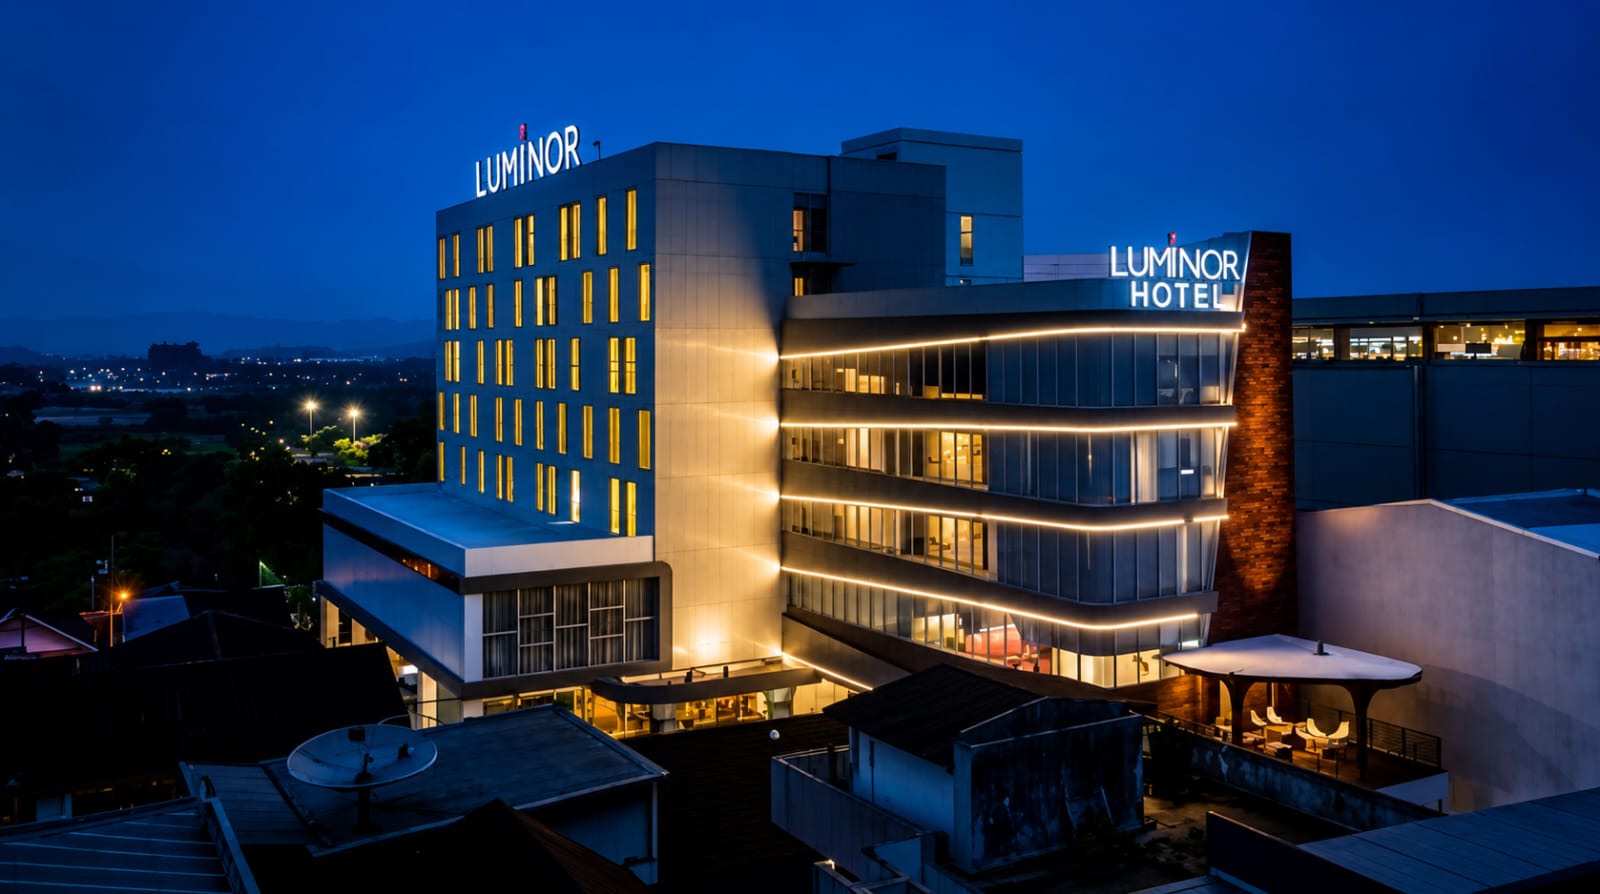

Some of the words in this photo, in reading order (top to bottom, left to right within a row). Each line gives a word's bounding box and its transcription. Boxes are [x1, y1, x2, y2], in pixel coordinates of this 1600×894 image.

[475, 124, 581, 198] LUMINOR
[1110, 245, 1241, 280] LUMINOR
[1130, 280, 1227, 309] HOTEL
